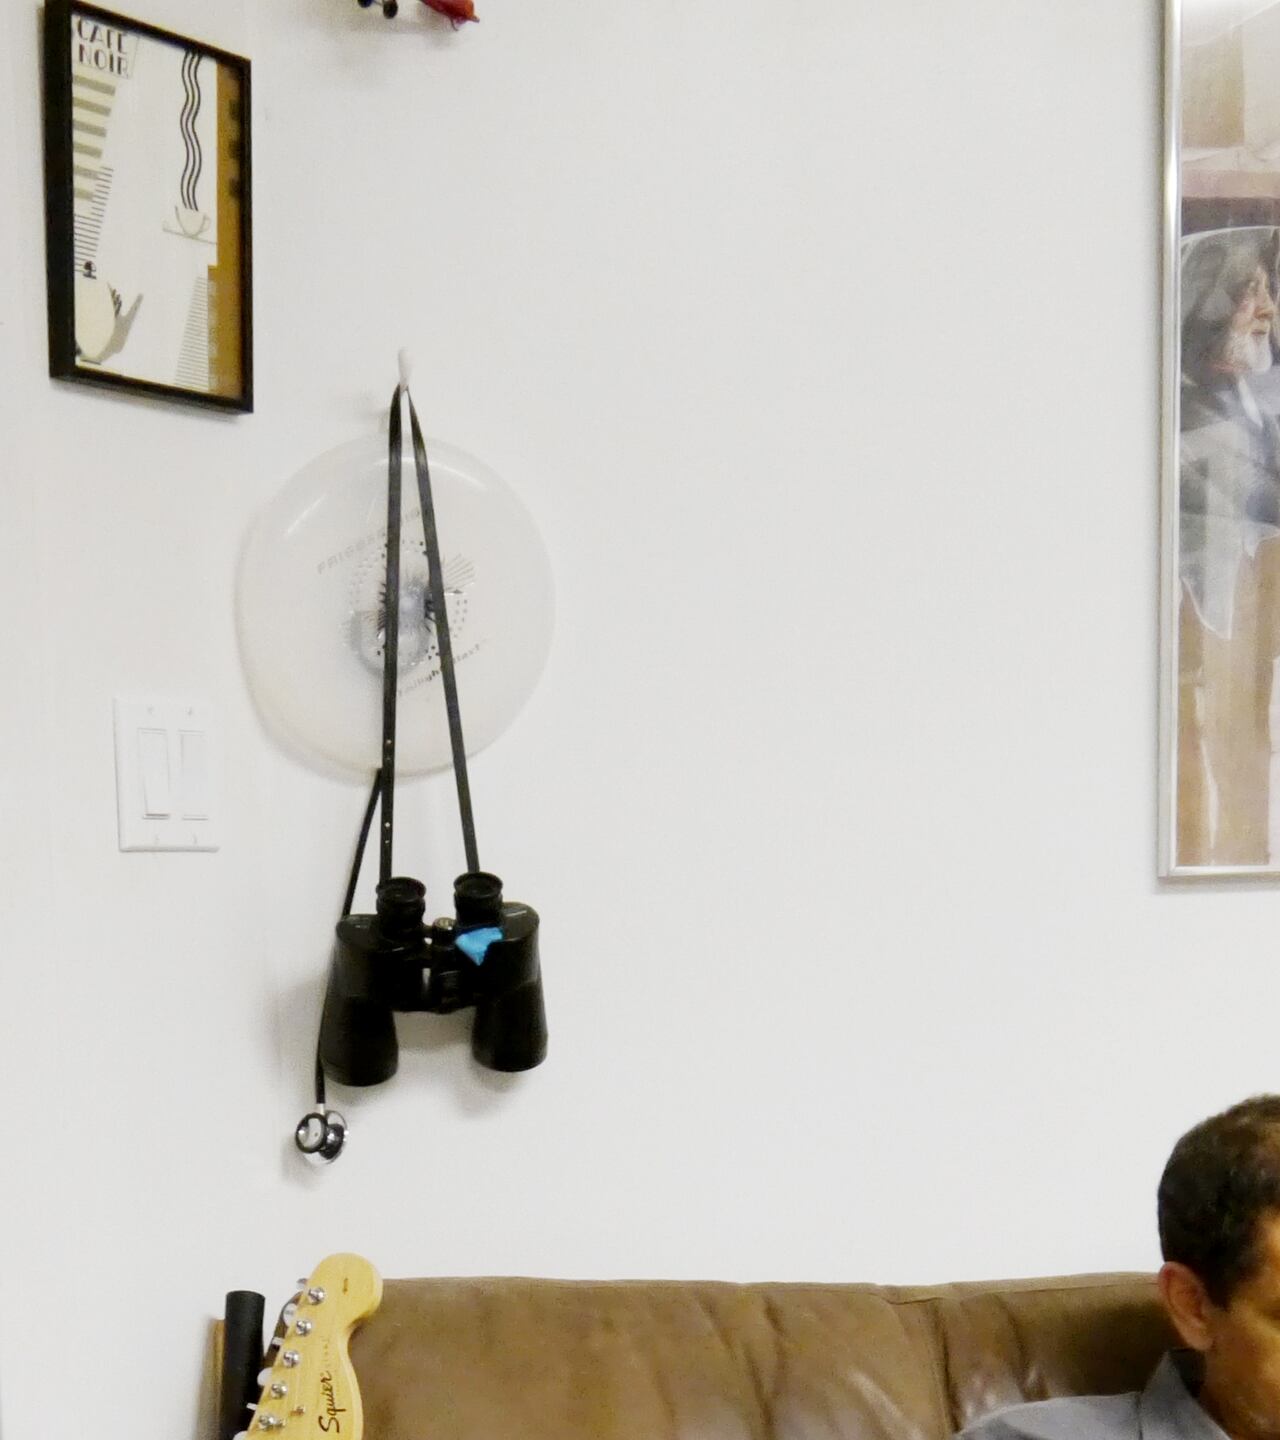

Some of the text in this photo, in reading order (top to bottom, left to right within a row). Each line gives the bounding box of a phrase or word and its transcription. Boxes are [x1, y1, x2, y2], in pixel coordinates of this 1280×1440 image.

[77, 18, 128, 54] CAFE
[79, 43, 129, 79] NOIR
[318, 1370, 347, 1433] Squier
